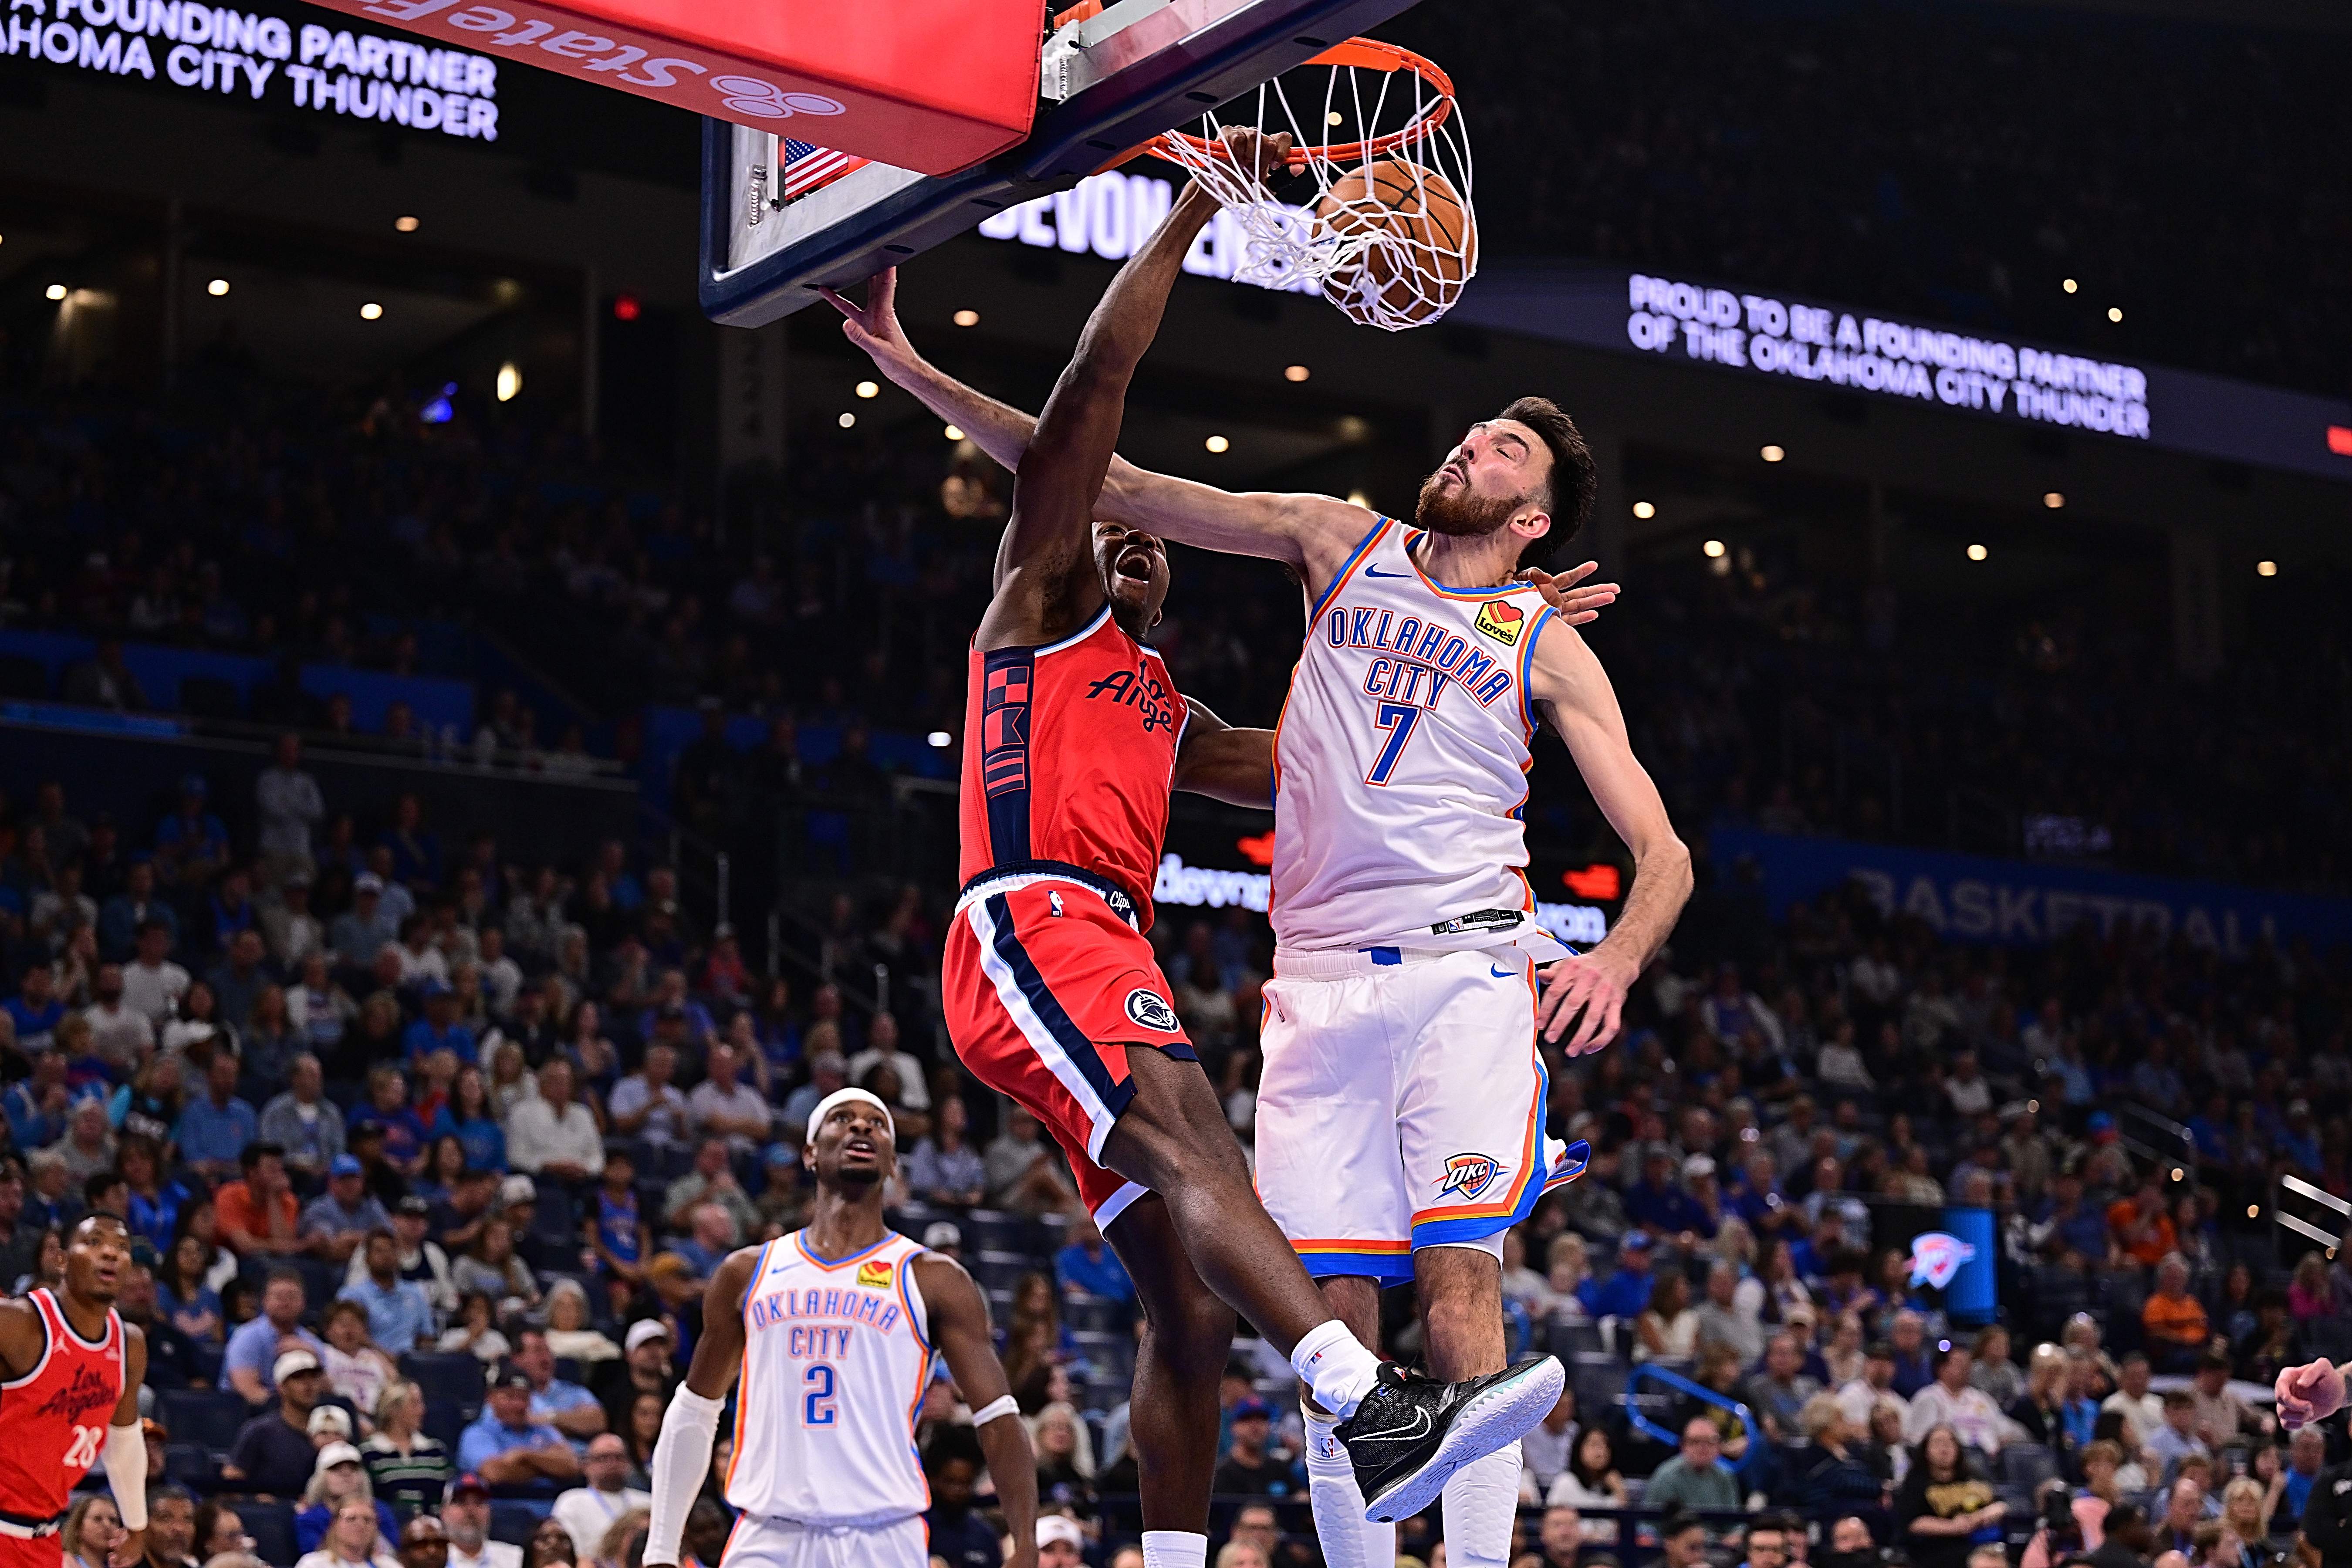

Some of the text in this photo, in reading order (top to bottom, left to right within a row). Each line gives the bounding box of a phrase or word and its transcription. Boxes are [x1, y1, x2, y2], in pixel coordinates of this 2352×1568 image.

[300, 24, 497, 98] PARTNER
[448, 6, 709, 87] State
[167, 44, 275, 99] CITY
[285, 64, 499, 142] THUNDER
[1629, 274, 2146, 404] PROUD TO BE A FOUNDING PARTNER
[1628, 311, 2150, 440] OF THE OKLAHOMA CITY THUNDER
[1139, 659, 1172, 711] Lo
[1328, 607, 1513, 708] OKLAHOMA
[1363, 657, 1451, 711] CITY
[1085, 670, 1173, 733] Ange
[1365, 700, 1422, 787] 7
[1109, 891, 1131, 912] Clips
[1444, 1162, 1488, 1190] OKC
[753, 1288, 901, 1335] OKLAHOMA
[789, 1325, 853, 1360] CITY
[801, 1361, 838, 1429] 2
[62, 1424, 103, 1469] 28
